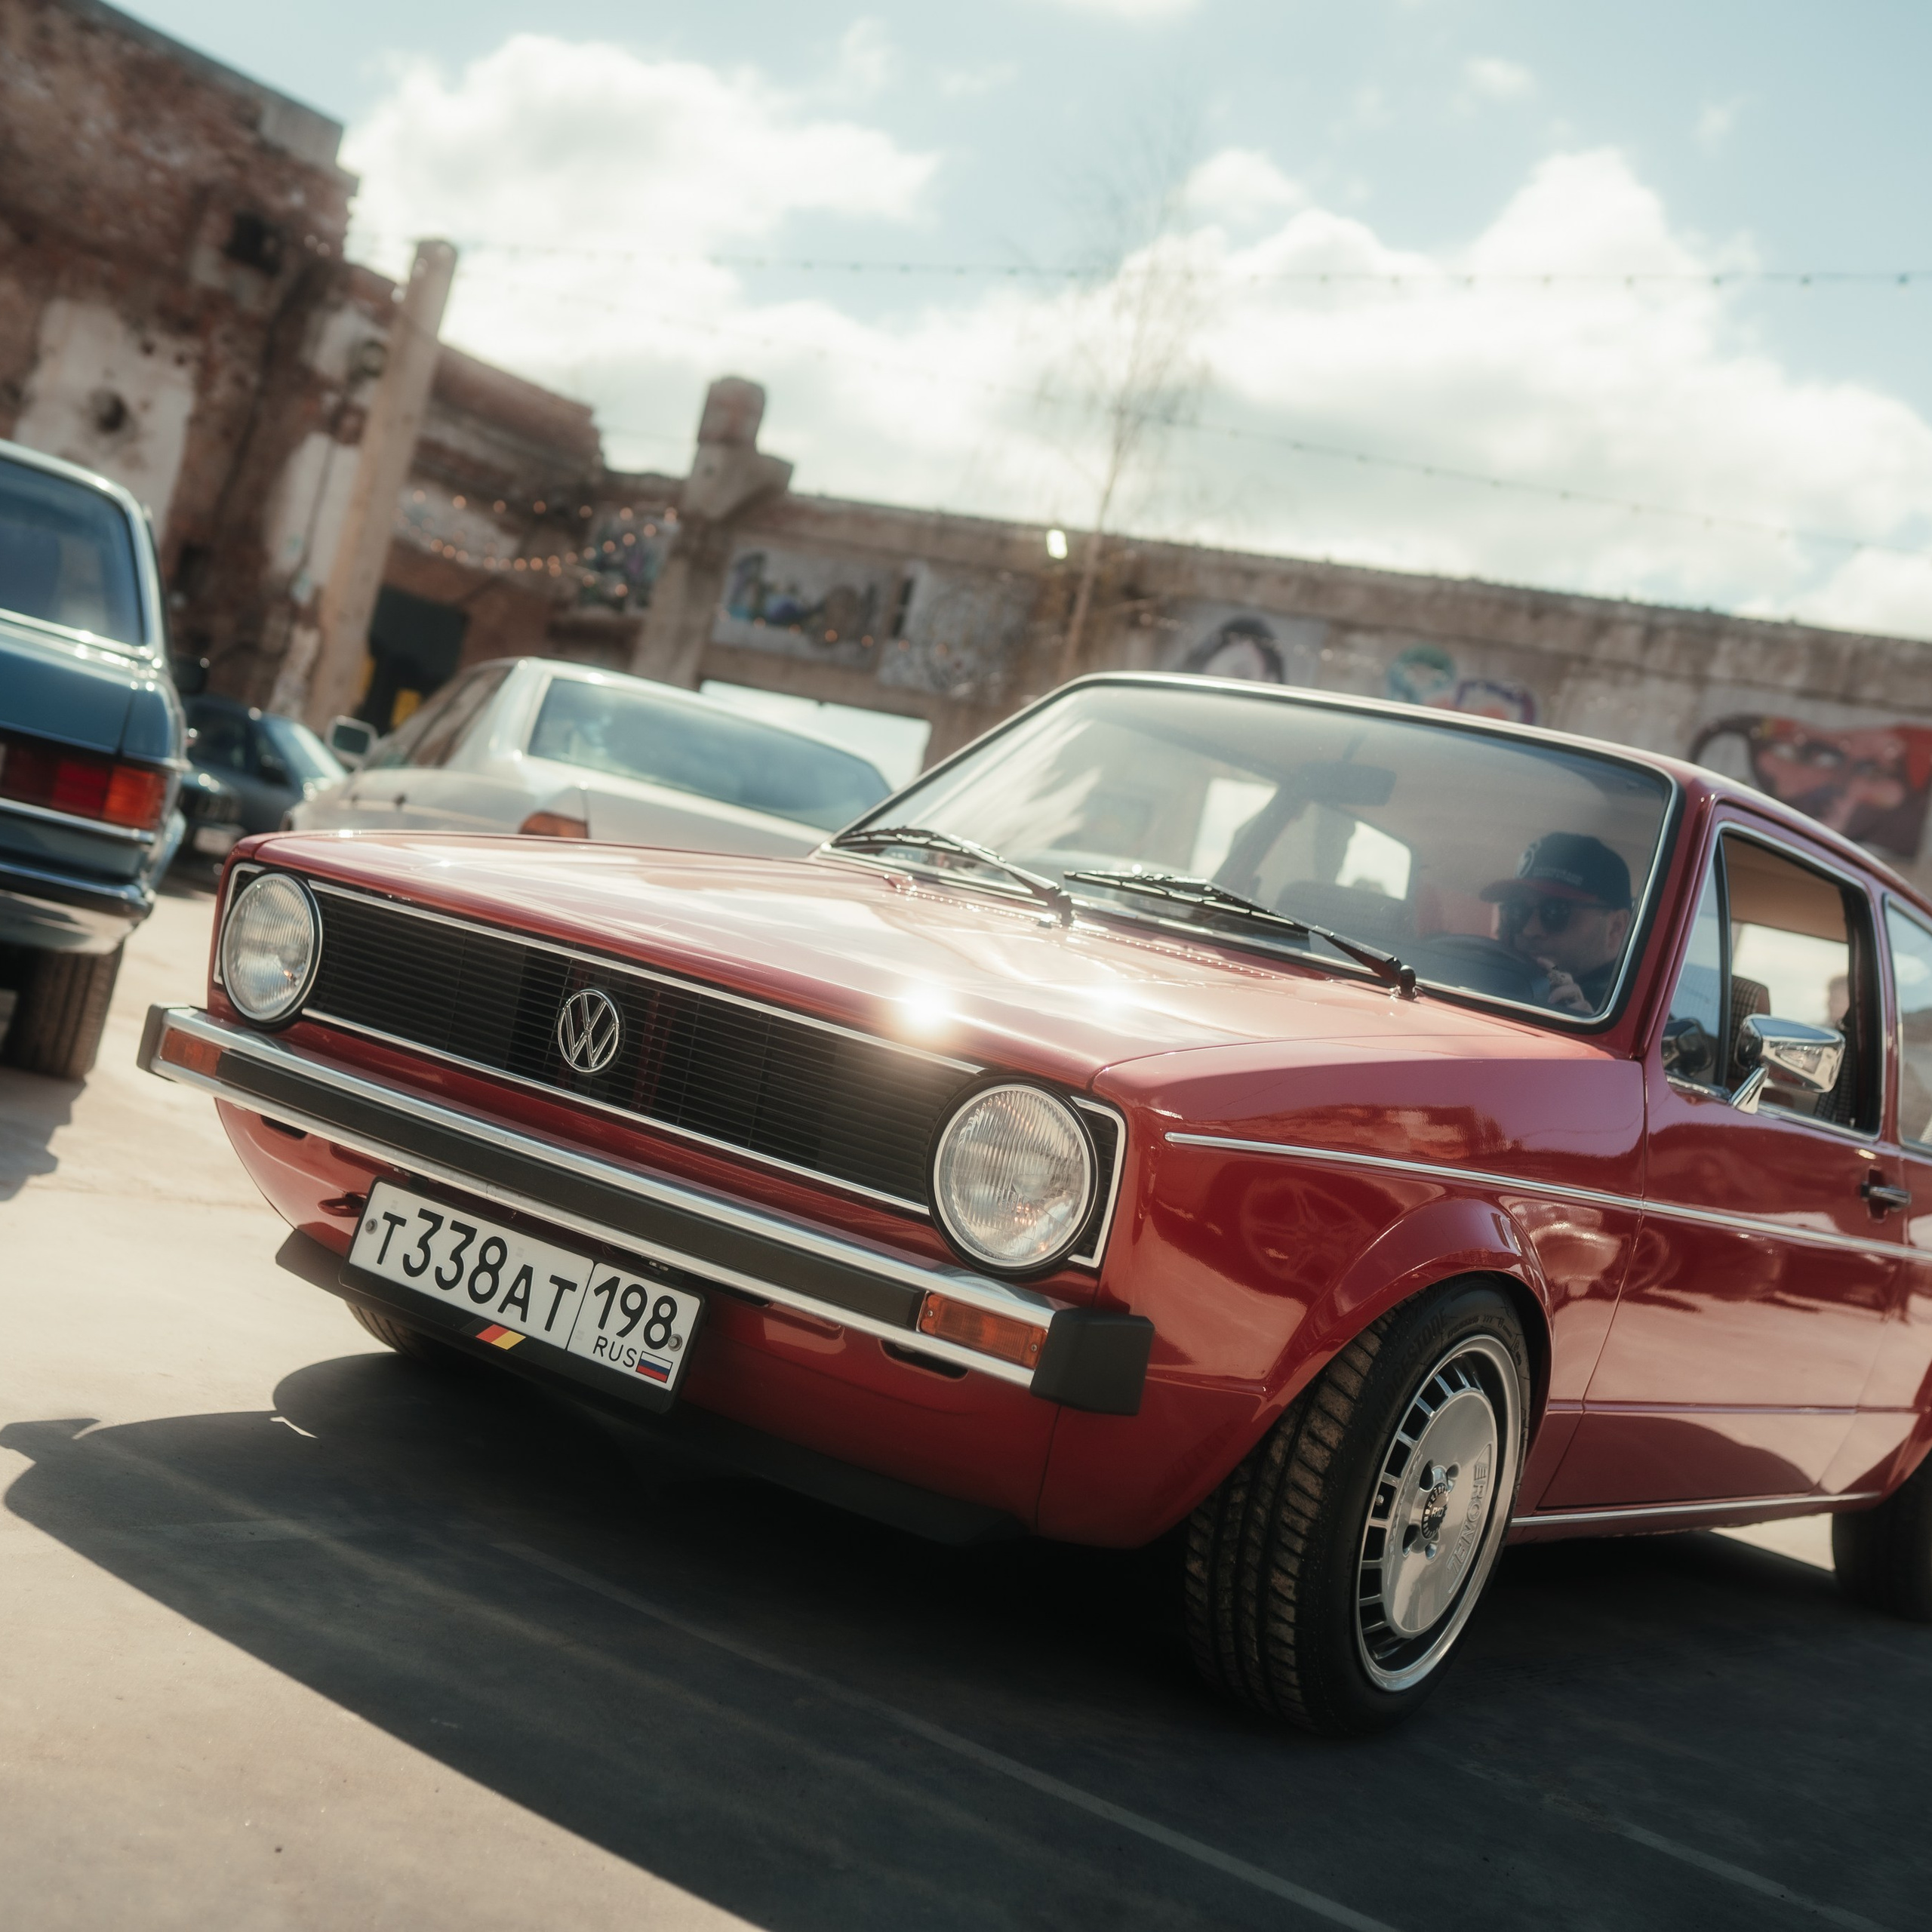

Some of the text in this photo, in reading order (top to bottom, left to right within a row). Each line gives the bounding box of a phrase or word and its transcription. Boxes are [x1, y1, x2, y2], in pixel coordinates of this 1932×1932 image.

[558, 989, 619, 1072] VW
[376, 1208, 678, 1350] T338AT 198
[592, 1336, 636, 1368] RUS
